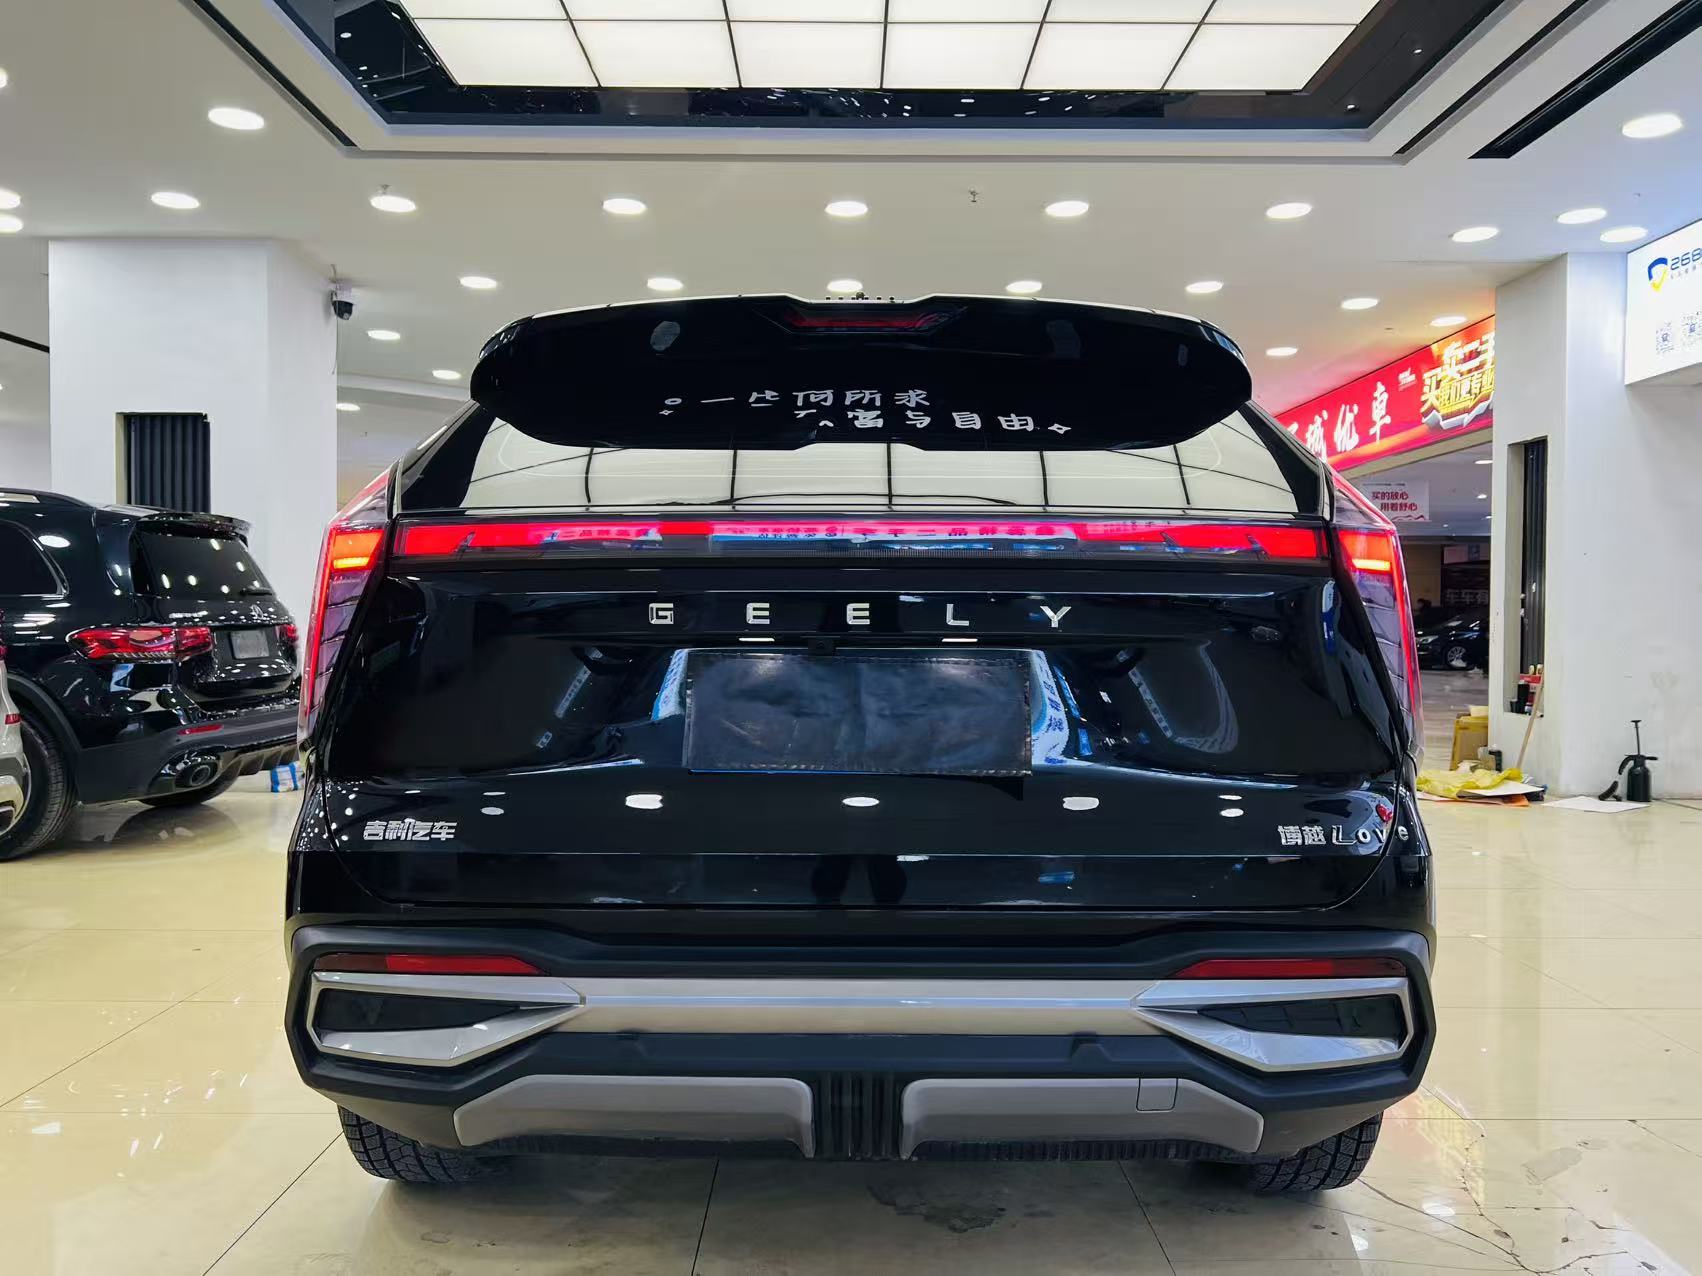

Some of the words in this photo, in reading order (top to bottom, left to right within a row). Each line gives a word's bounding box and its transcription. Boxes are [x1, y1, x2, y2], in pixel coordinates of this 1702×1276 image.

[1372, 491, 1409, 500] 买的放心
[1380, 502, 1418, 512] 用着舒心
[649, 602, 1072, 628] GEELY
[363, 818, 457, 841] 吉利汽车
[1278, 825, 1326, 846] 博越
